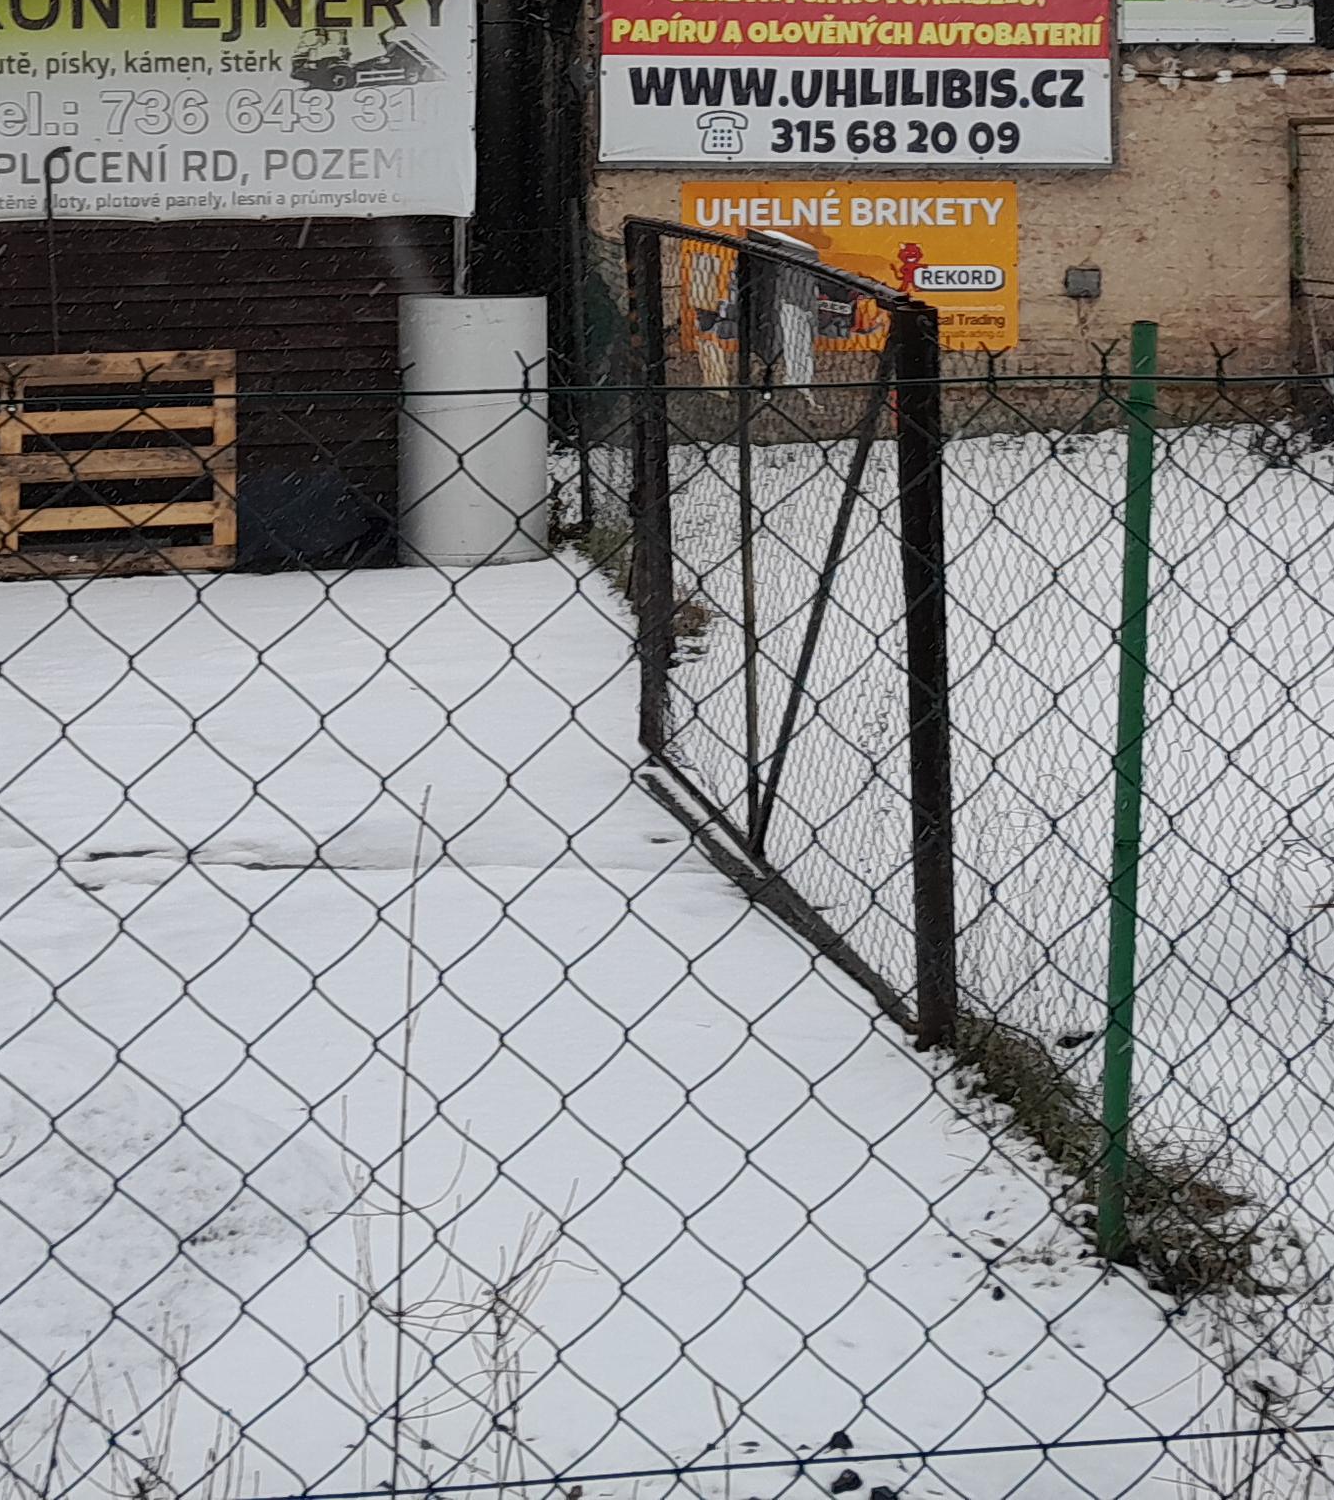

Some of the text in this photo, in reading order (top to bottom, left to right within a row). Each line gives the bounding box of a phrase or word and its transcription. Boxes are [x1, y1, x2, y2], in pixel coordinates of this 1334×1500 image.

[611, 12, 1106, 47] PAPÍRU A OLOVĚNÝCH AUTOBATERIÍ
[45, 51, 116, 80] písky,
[124, 50, 212, 76] kámen,
[220, 49, 283, 73] štěrk
[628, 67, 1085, 109] WWW.UHLILIBIS.CZ
[99, 88, 209, 136] 736
[226, 88, 335, 134] 643
[351, 87, 435, 133] 31
[770, 119, 1020, 154] 315 68 20 09
[183, 149, 248, 186] RD,
[265, 147, 414, 181] POZEM
[96, 192, 161, 213] plotové
[231, 191, 272, 206] lesní
[276, 194, 286, 206] a
[695, 188, 1004, 228] UHELNÉ BRIKETY
[921, 269, 997, 286] REKORD
[956, 313, 1006, 329] Trading
